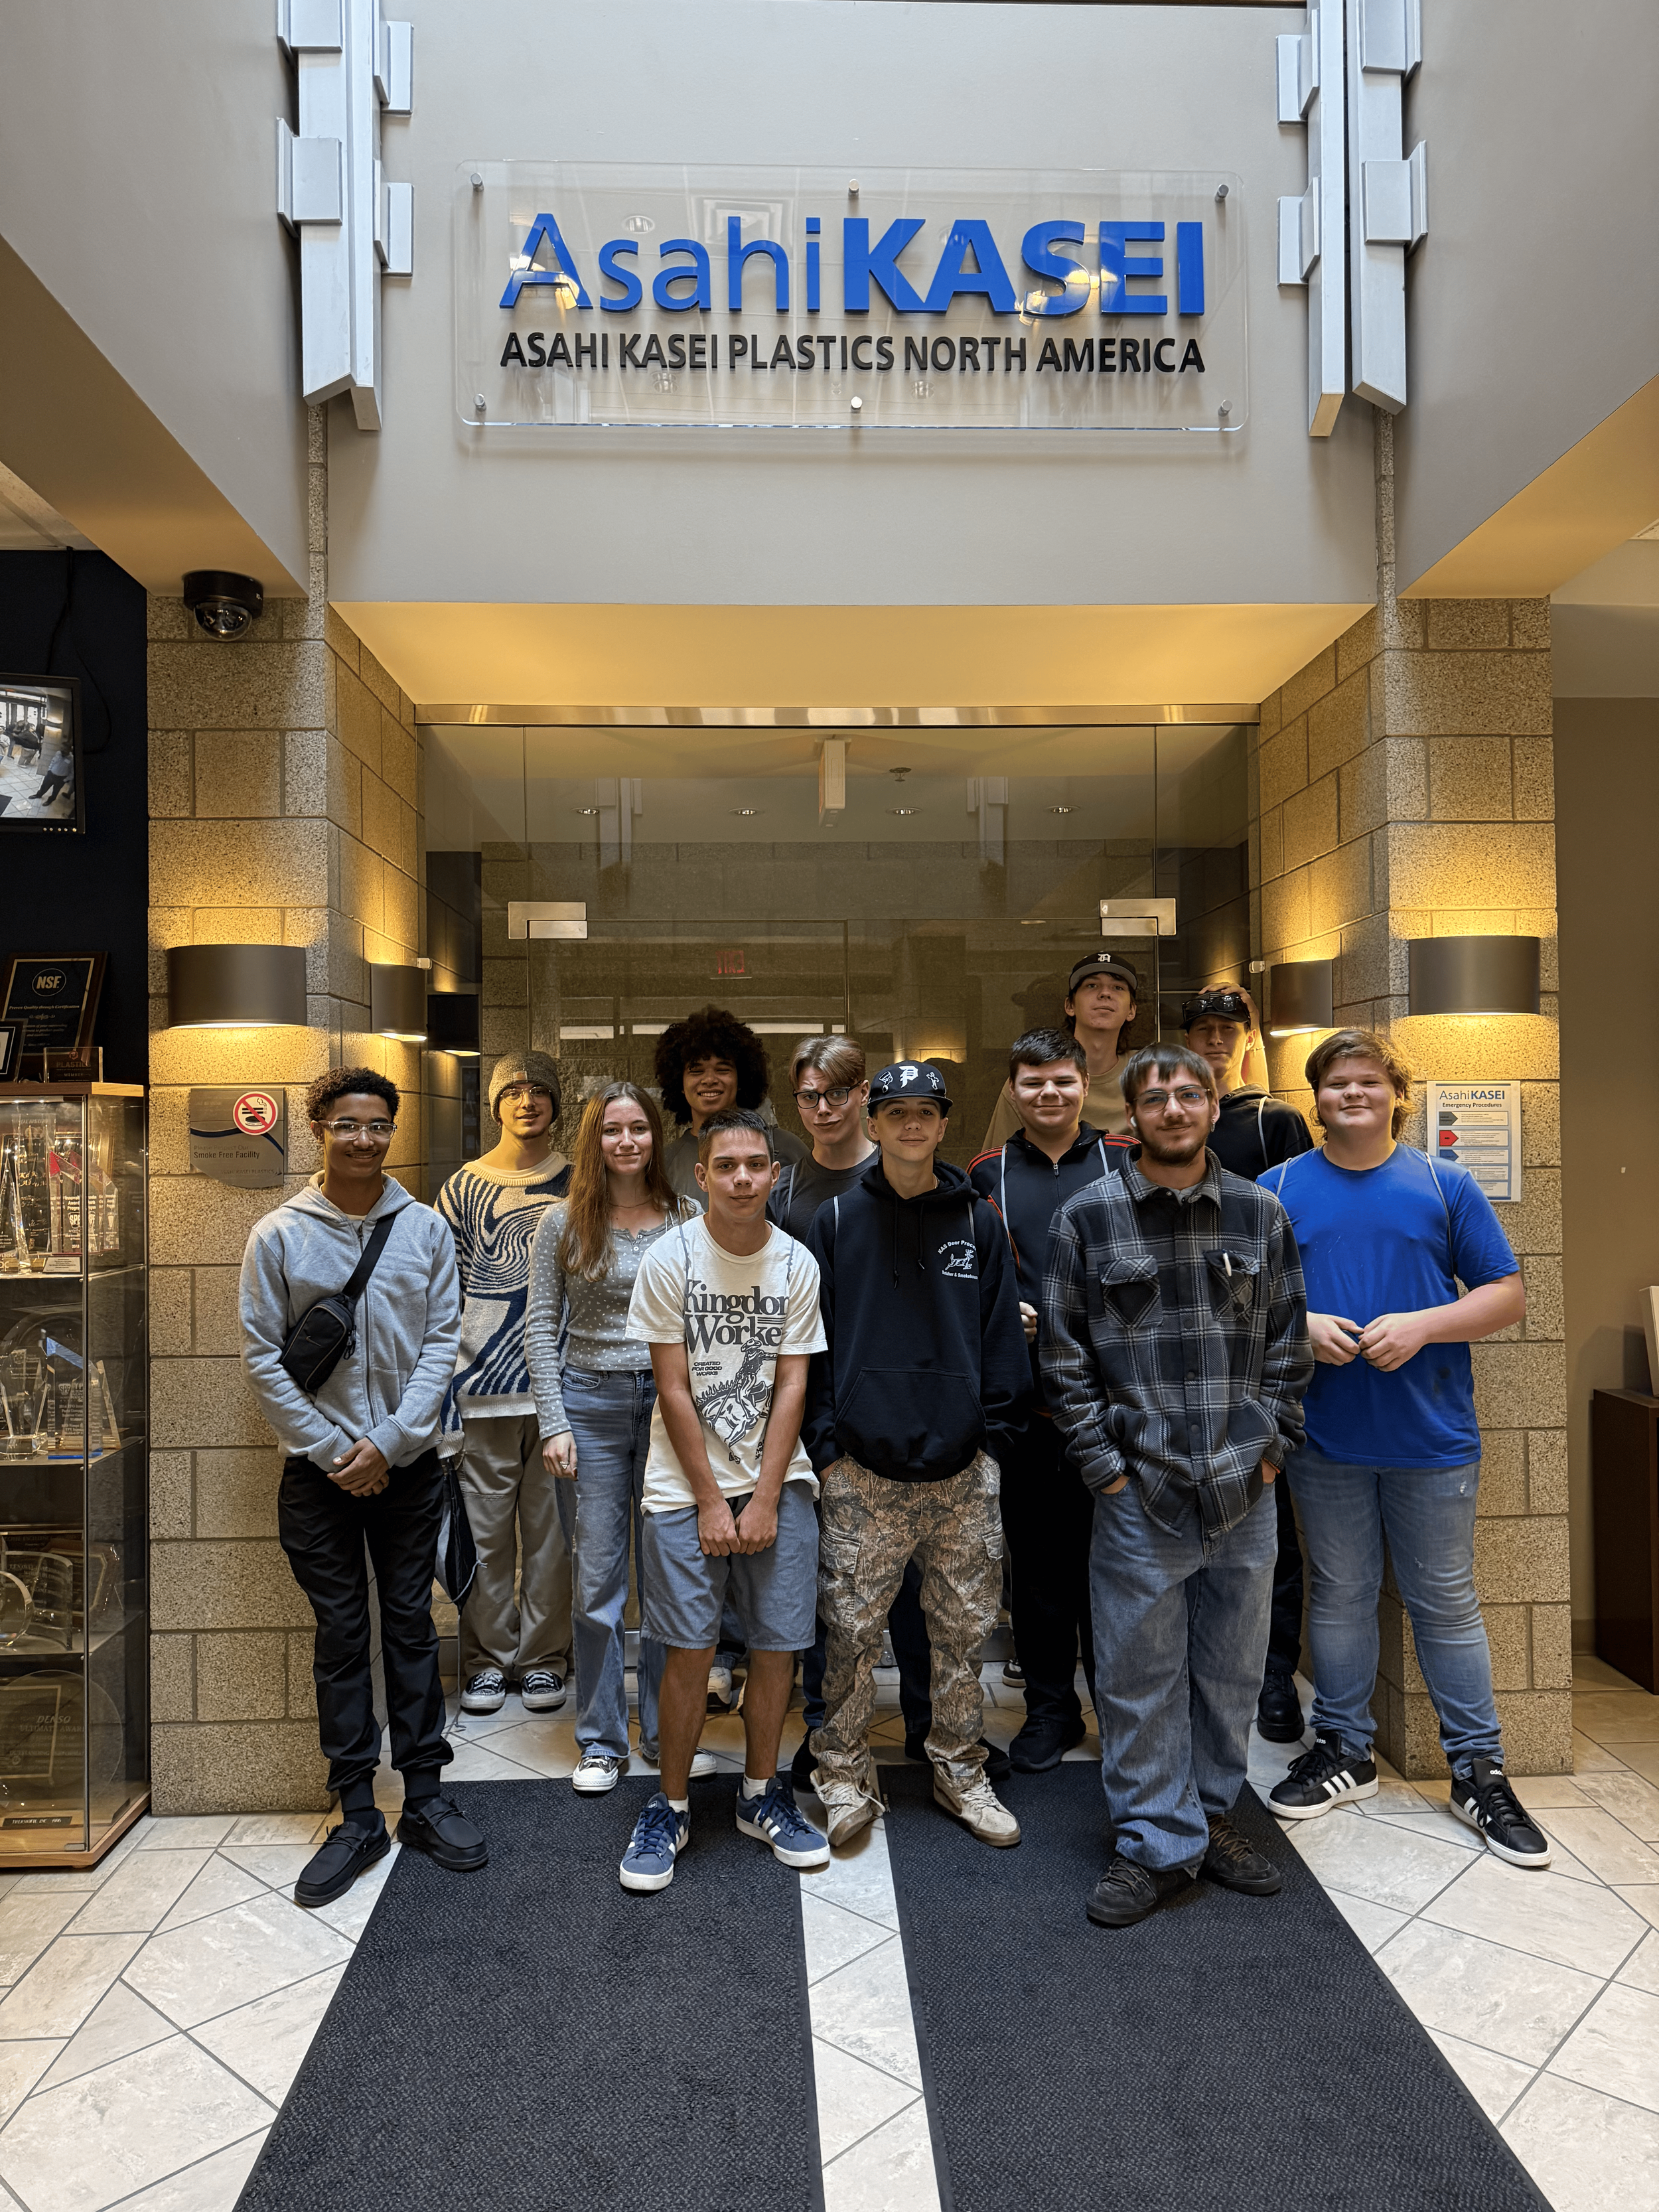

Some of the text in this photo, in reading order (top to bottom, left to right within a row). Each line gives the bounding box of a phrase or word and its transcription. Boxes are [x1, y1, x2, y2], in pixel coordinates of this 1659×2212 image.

[500, 331, 1206, 374] ASAHI KASEI PLASTICS NORTH AMERICA
[236, 1151, 260, 1159] Facility
